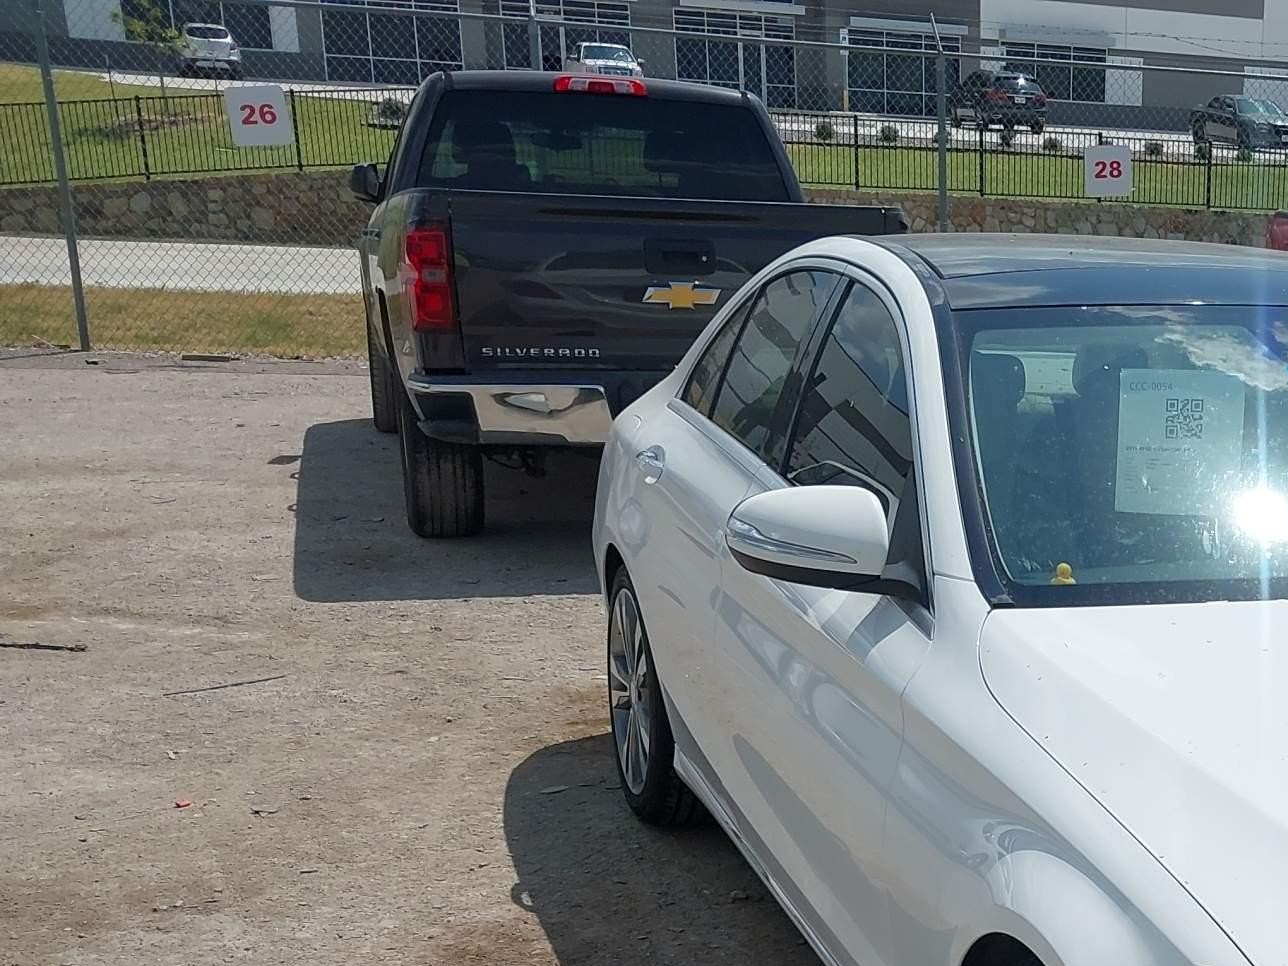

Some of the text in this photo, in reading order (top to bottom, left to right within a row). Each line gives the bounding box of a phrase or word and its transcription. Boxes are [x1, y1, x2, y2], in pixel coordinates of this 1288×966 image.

[240, 103, 277, 126] 26
[1094, 160, 1122, 179] 28
[481, 347, 600, 358] SILVERADO
